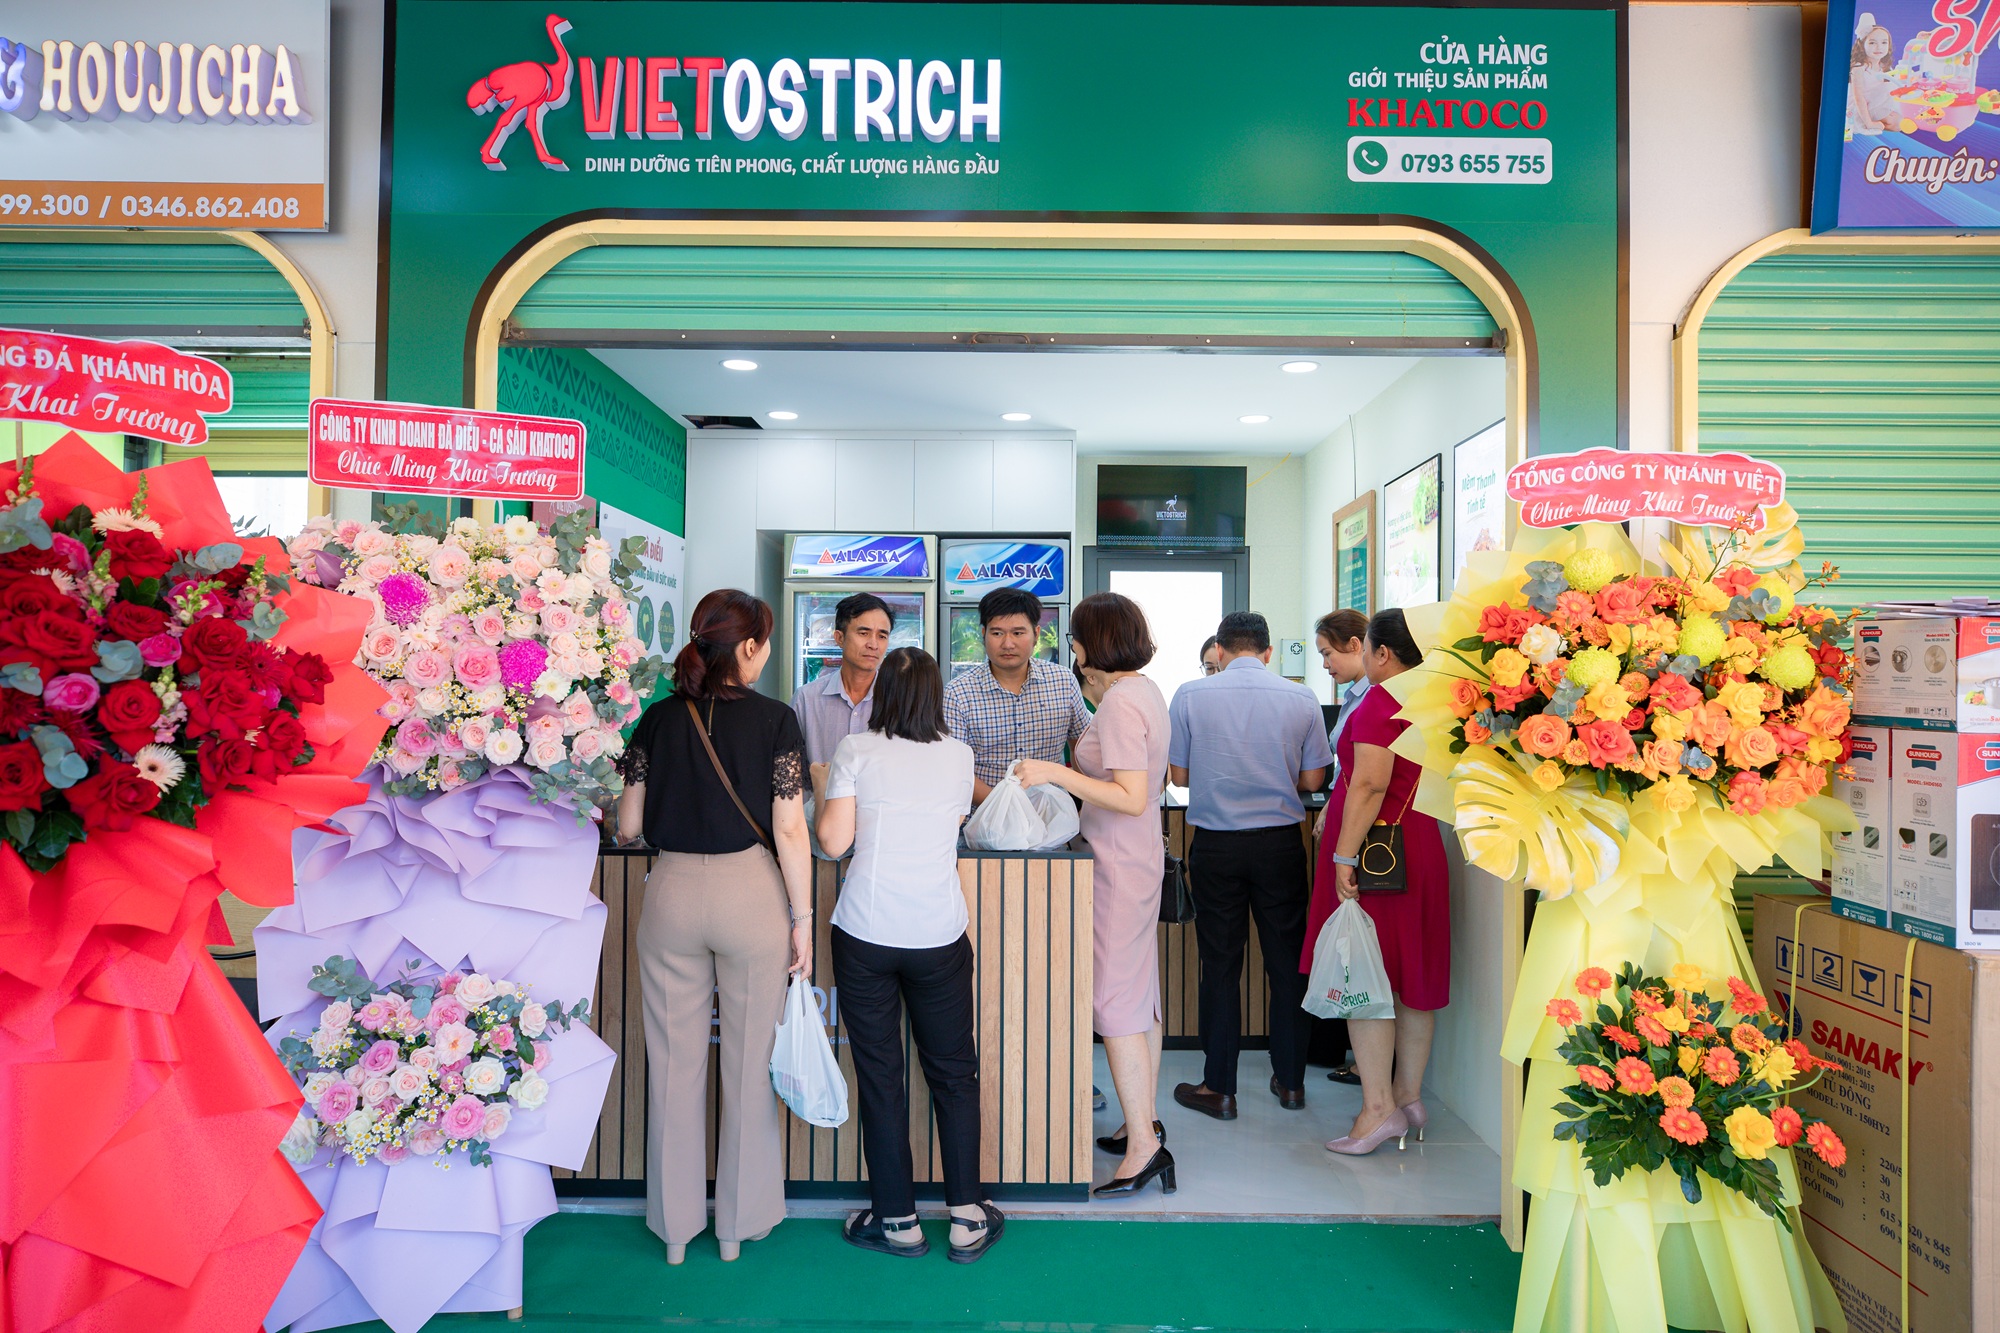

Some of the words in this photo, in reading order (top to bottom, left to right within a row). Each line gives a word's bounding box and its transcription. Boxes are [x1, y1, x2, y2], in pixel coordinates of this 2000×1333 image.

[1420, 35, 1470, 64] CỬA
[1478, 35, 1548, 66] HÀNG
[40, 40, 302, 118] HOUJICHA
[1348, 66, 1387, 88] GIỚI
[1394, 68, 1448, 92] THIỆU
[1453, 67, 1489, 89] SẢN
[1494, 66, 1548, 89] PHẨM
[1347, 98, 1549, 130] KHATOCO
[585, 157, 626, 173] DINH
[630, 153, 690, 174] DƯỠNG
[695, 155, 732, 174] TIÊN
[735, 157, 797, 176] PHONG,
[801, 151, 845, 174] CHẤT
[851, 156, 908, 180] LƯỢNG
[912, 154, 961, 175] HÀNG
[964, 153, 1000, 175] ĐẦU
[1401, 153, 1454, 173] 0793
[1459, 154, 1500, 173] 655
[1506, 155, 1546, 174] 755
[1864, 146, 1999, 195] Chuyên:
[121, 195, 300, 219] 0346.862.408
[33, 344, 75, 373] ĐÁ
[82, 352, 166, 387] KHÁNH
[173, 364, 226, 400] HÒA
[0, 382, 80, 417] Khai
[92, 392, 196, 444] Trương
[319, 410, 351, 443] CÔNG
[353, 417, 368, 444] TY
[370, 417, 396, 447] KINH
[400, 420, 435, 449] DOANH
[438, 419, 453, 450] ĐÀ
[455, 416, 480, 452] ĐIỂU
[489, 425, 503, 454] CÁ
[506, 422, 527, 456] SẤU
[529, 431, 575, 461] KHATOCO
[337, 450, 382, 476] Chúc
[385, 453, 437, 484] Mừng
[442, 457, 489, 484] Khai
[495, 461, 558, 492] Trương
[1511, 460, 1565, 490] TỔNG
[1571, 461, 1625, 483] CÔNG
[1664, 462, 1726, 485] KHÁNH
[1733, 468, 1779, 496] VIỆT
[1530, 501, 1573, 526] Chúc
[1577, 493, 1631, 516] Mừng
[1636, 490, 1684, 512] Khai
[835, 549, 900, 564] ALASKA
[976, 564, 1053, 579] ALASKA
[1853, 742, 1876, 750] UNHOUSE
[1908, 750, 1940, 759] SUNHOUSE
[1811, 1019, 1926, 1086] SANAKY
[1824, 1051, 1837, 1063] ISO
[1837, 1057, 1855, 1072] 9001:
[1856, 1065, 1871, 1079] 2015
[1822, 1075, 1836, 1093] TỦ
[1839, 1085, 1871, 1110] ĐÔNG
[1859, 1080, 1875, 1093] 2015
[1806, 1087, 1838, 1109] MODEL:
[1840, 1101, 1853, 1117] VH
[1859, 1112, 1891, 1136] 150HY2
[1880, 1173, 1890, 1187] 30
[1880, 1189, 1890, 1203] 33
[1880, 1207, 1896, 1223] 615
[1933, 1238, 1951, 1257] 845
[1880, 1223, 1896, 1240] 690
[1933, 1256, 1951, 1275] 895
[1841, 1277, 1873, 1305] SANAKY
[1874, 1300, 1894, 1321] VIỆT
